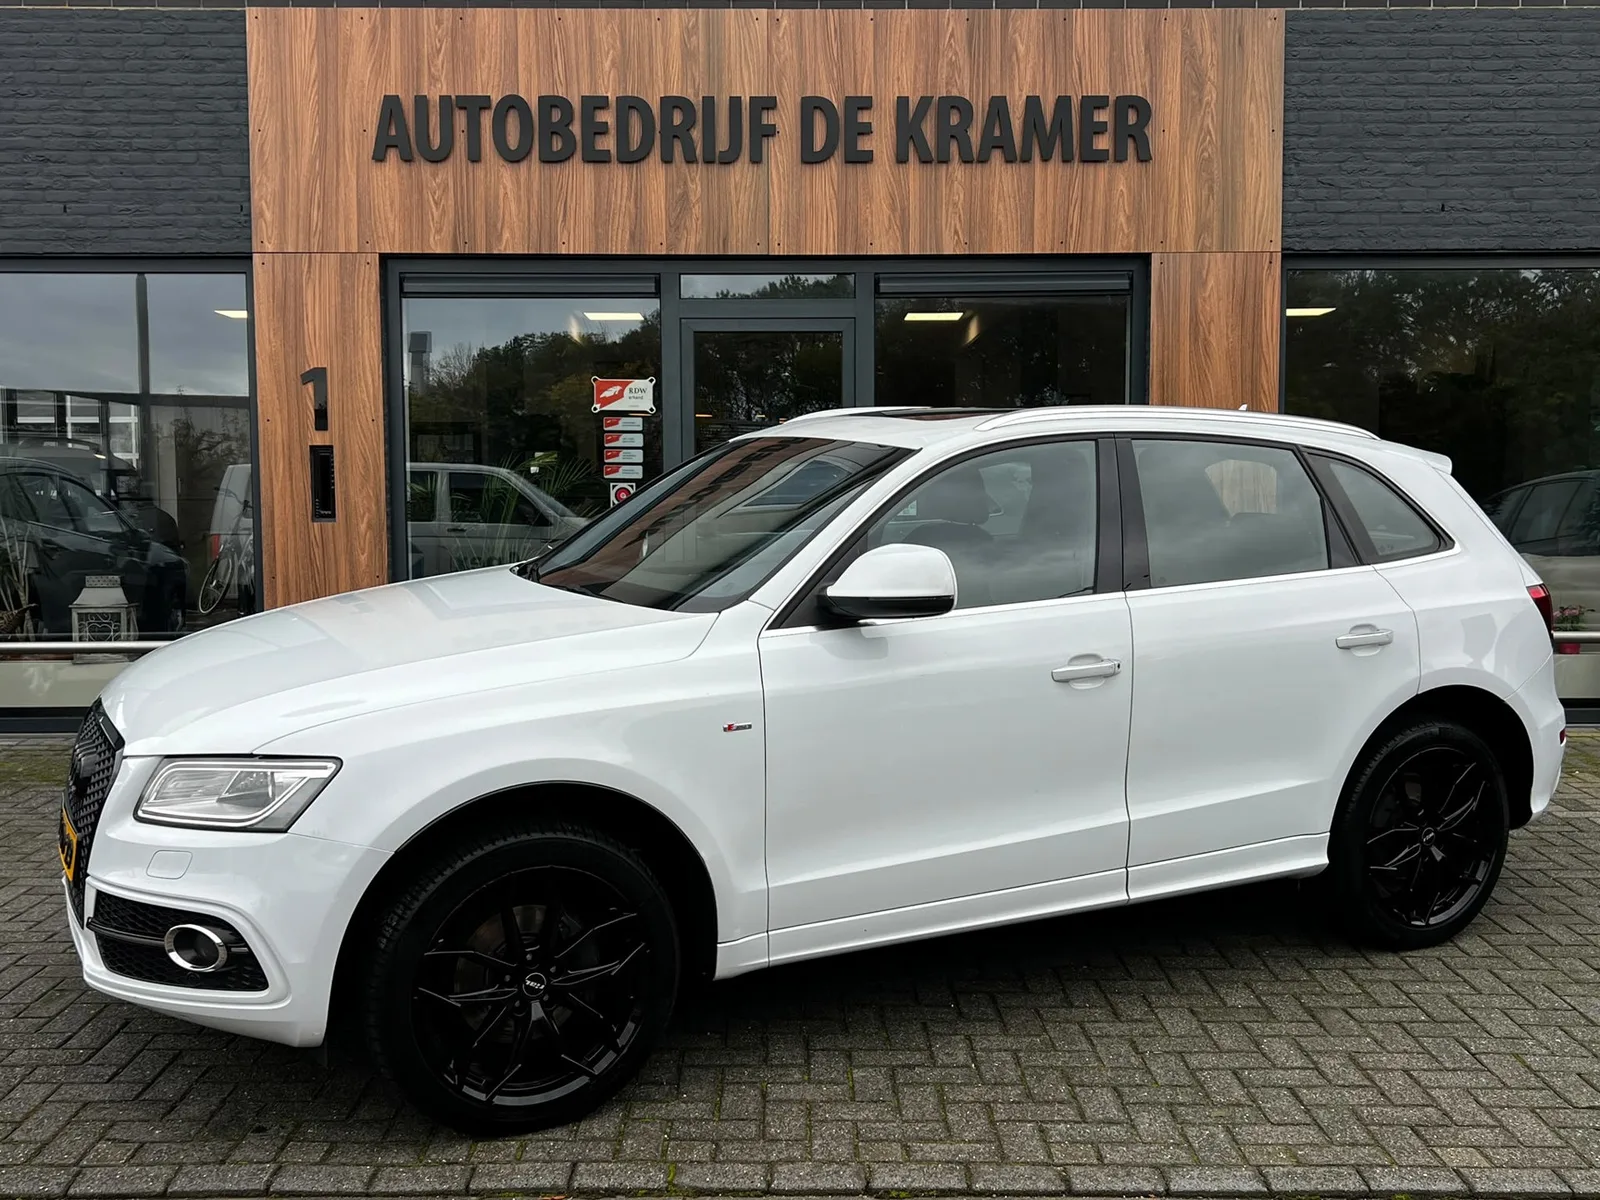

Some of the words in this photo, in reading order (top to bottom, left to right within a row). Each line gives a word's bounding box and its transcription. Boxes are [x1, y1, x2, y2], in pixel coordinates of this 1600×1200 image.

[372, 95, 778, 165] AUTOBEDRIJF
[800, 95, 874, 165] DE
[895, 95, 1153, 165] KRAMER
[300, 367, 328, 431] 1
[628, 387, 648, 395] RDW
